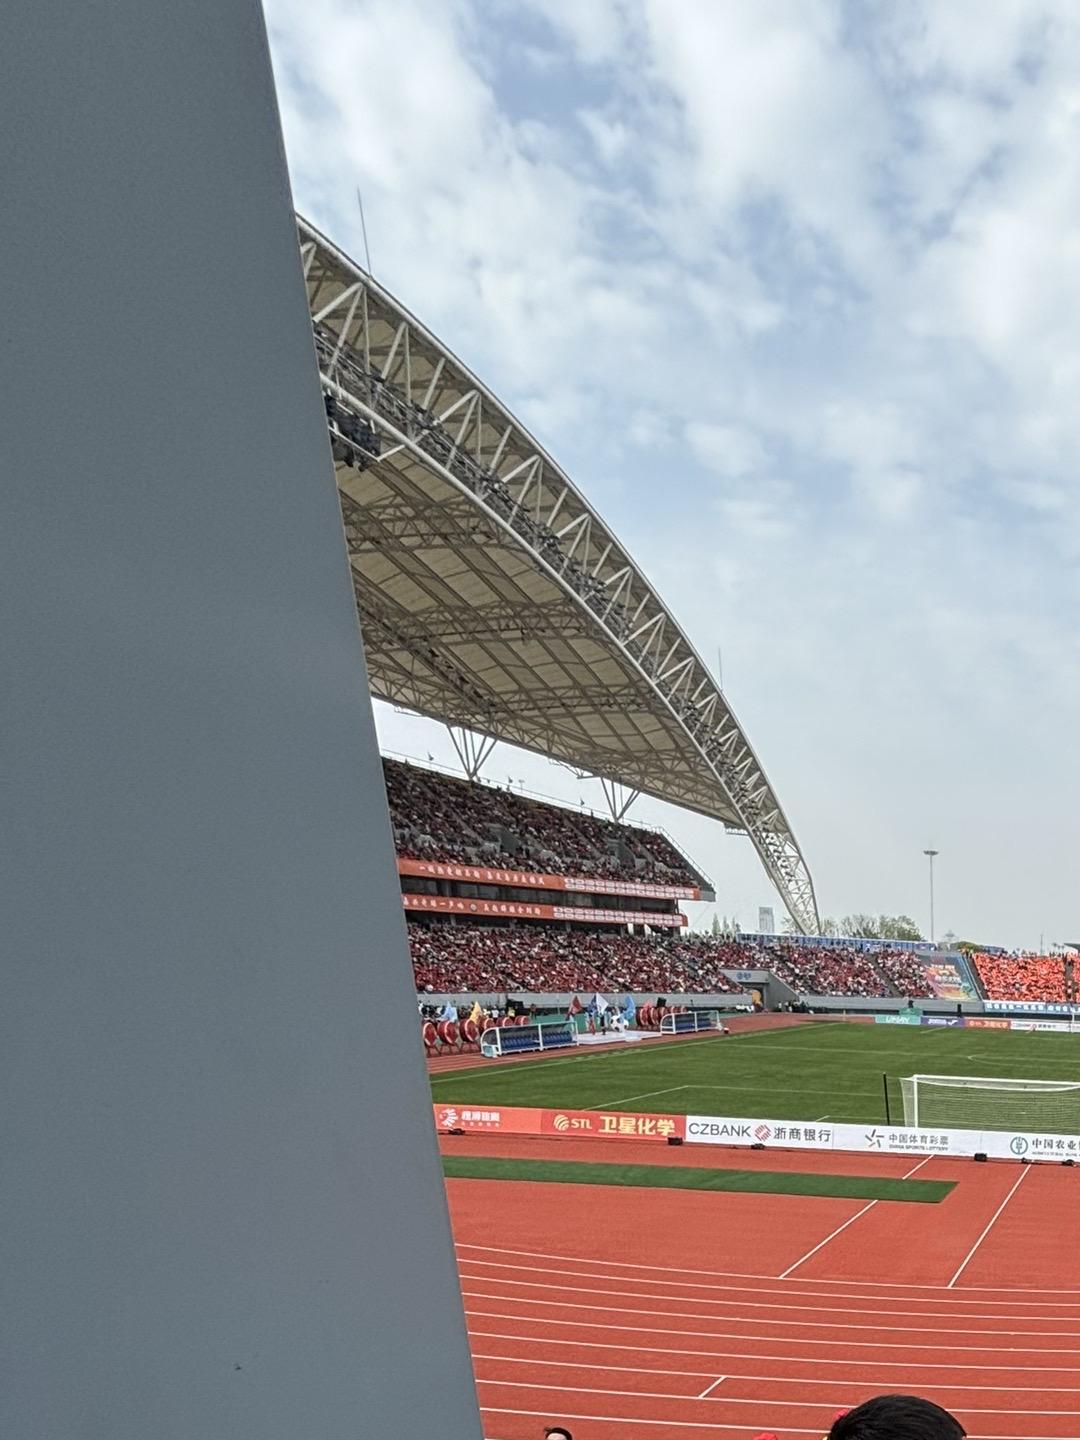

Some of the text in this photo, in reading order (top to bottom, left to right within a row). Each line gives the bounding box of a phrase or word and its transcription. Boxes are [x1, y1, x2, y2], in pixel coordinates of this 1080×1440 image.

[598, 1116, 676, 1137] 卫星化学
[688, 1122, 831, 1142] CZBANK 浙商银行
[889, 1133, 949, 1145] 中国体育彩票
